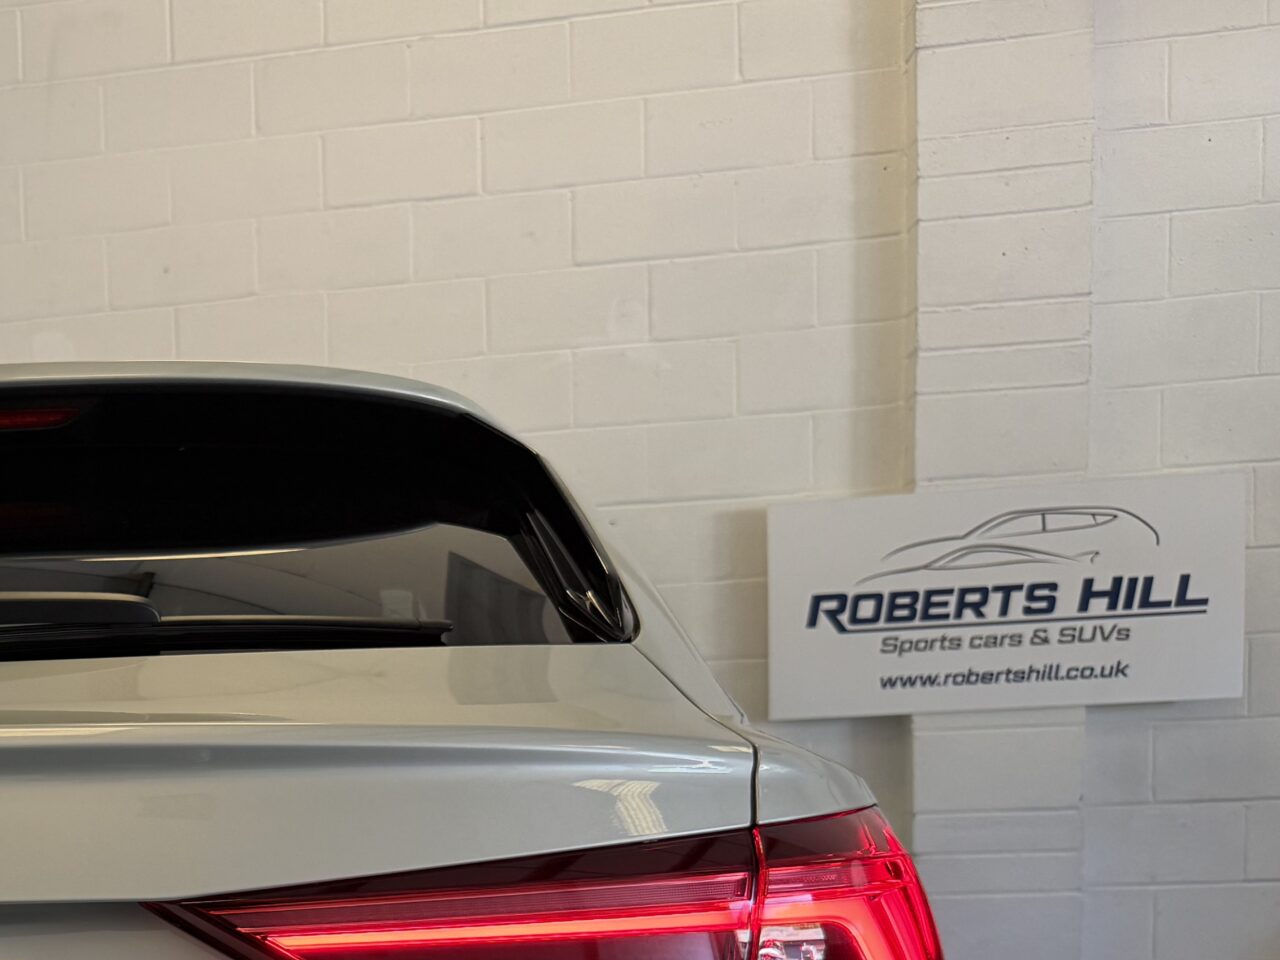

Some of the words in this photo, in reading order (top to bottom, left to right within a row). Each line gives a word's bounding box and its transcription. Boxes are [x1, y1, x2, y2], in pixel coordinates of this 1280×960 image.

[806, 581, 1059, 634] ROBERTS
[1077, 574, 1210, 613] HILL
[880, 631, 962, 657] Sports
[969, 631, 1023, 650] cars
[1029, 628, 1050, 647] &
[1057, 624, 1131, 645] SUVs
[880, 660, 1129, 690] www.robertshill.co.uk
